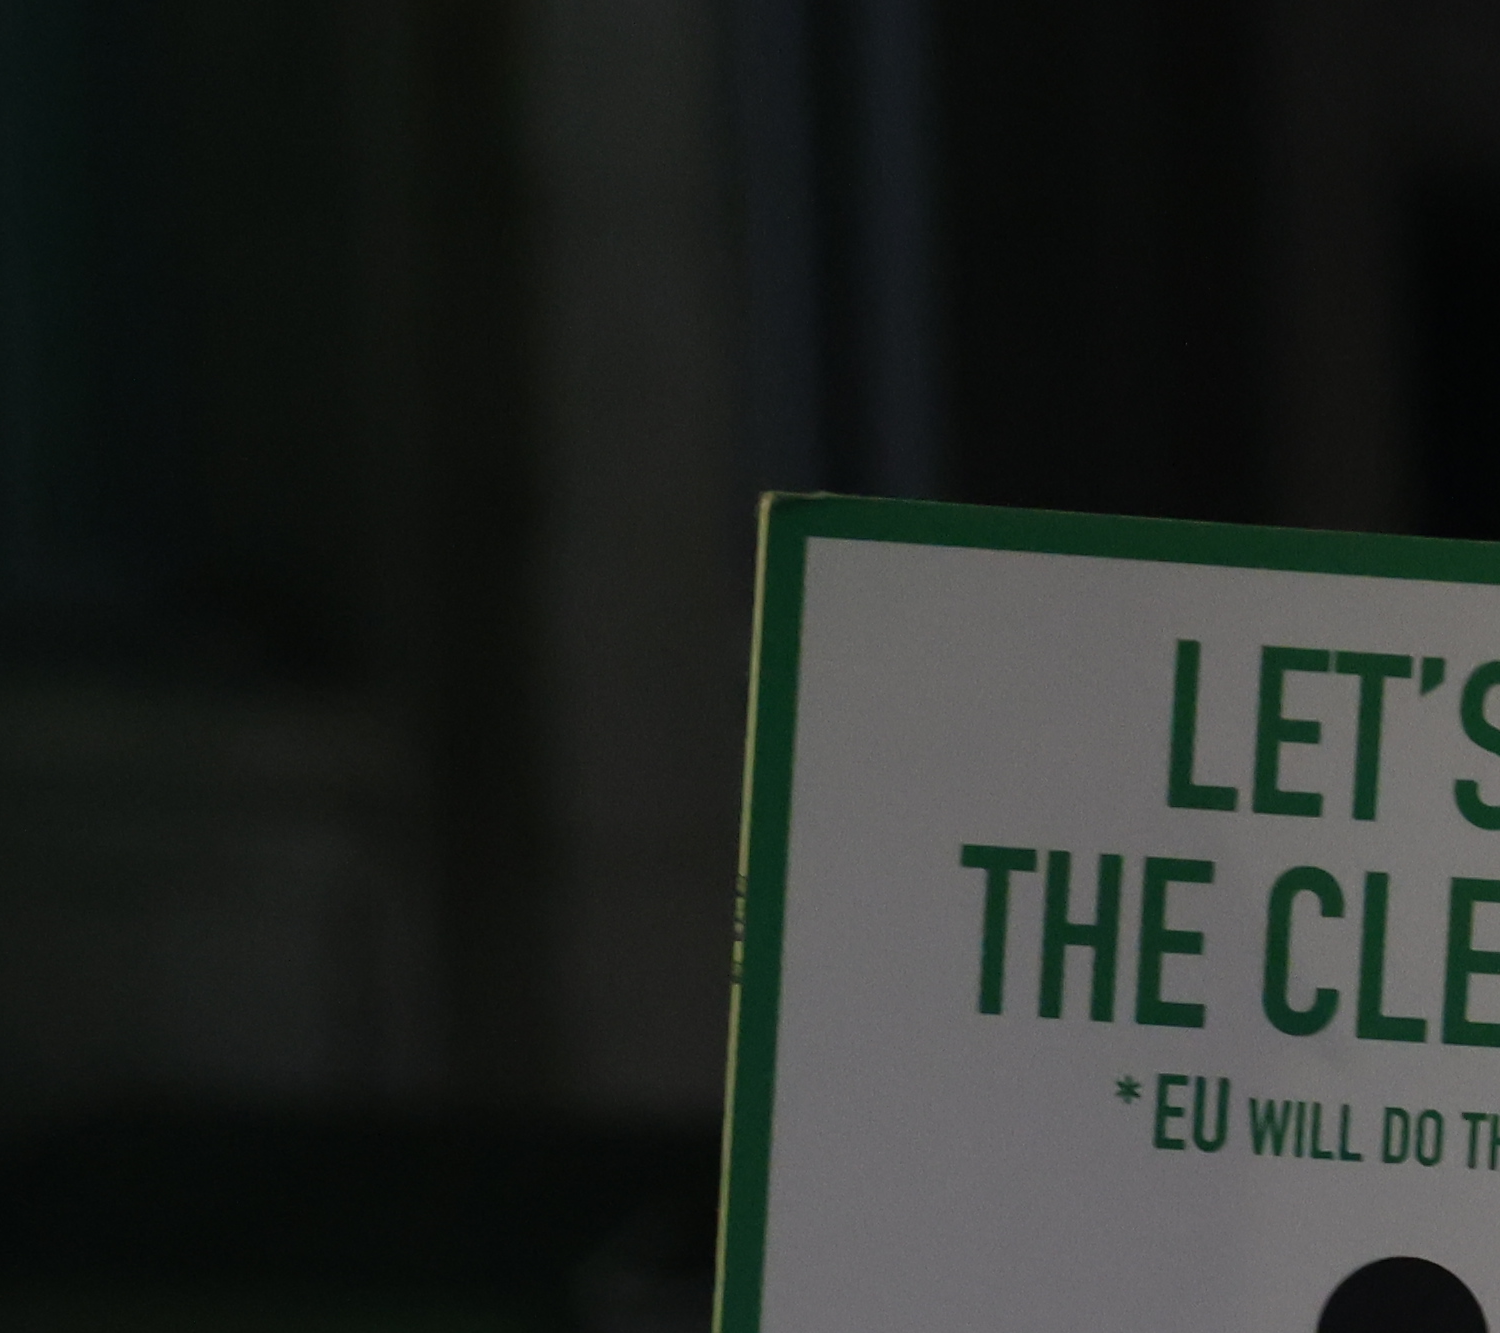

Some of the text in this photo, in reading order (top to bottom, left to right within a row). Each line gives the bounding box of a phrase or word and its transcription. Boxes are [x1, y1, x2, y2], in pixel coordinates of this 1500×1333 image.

[958, 843, 1217, 1030] THE
[1247, 1097, 1365, 1164] WILL
[1380, 1105, 1446, 1168] DO
